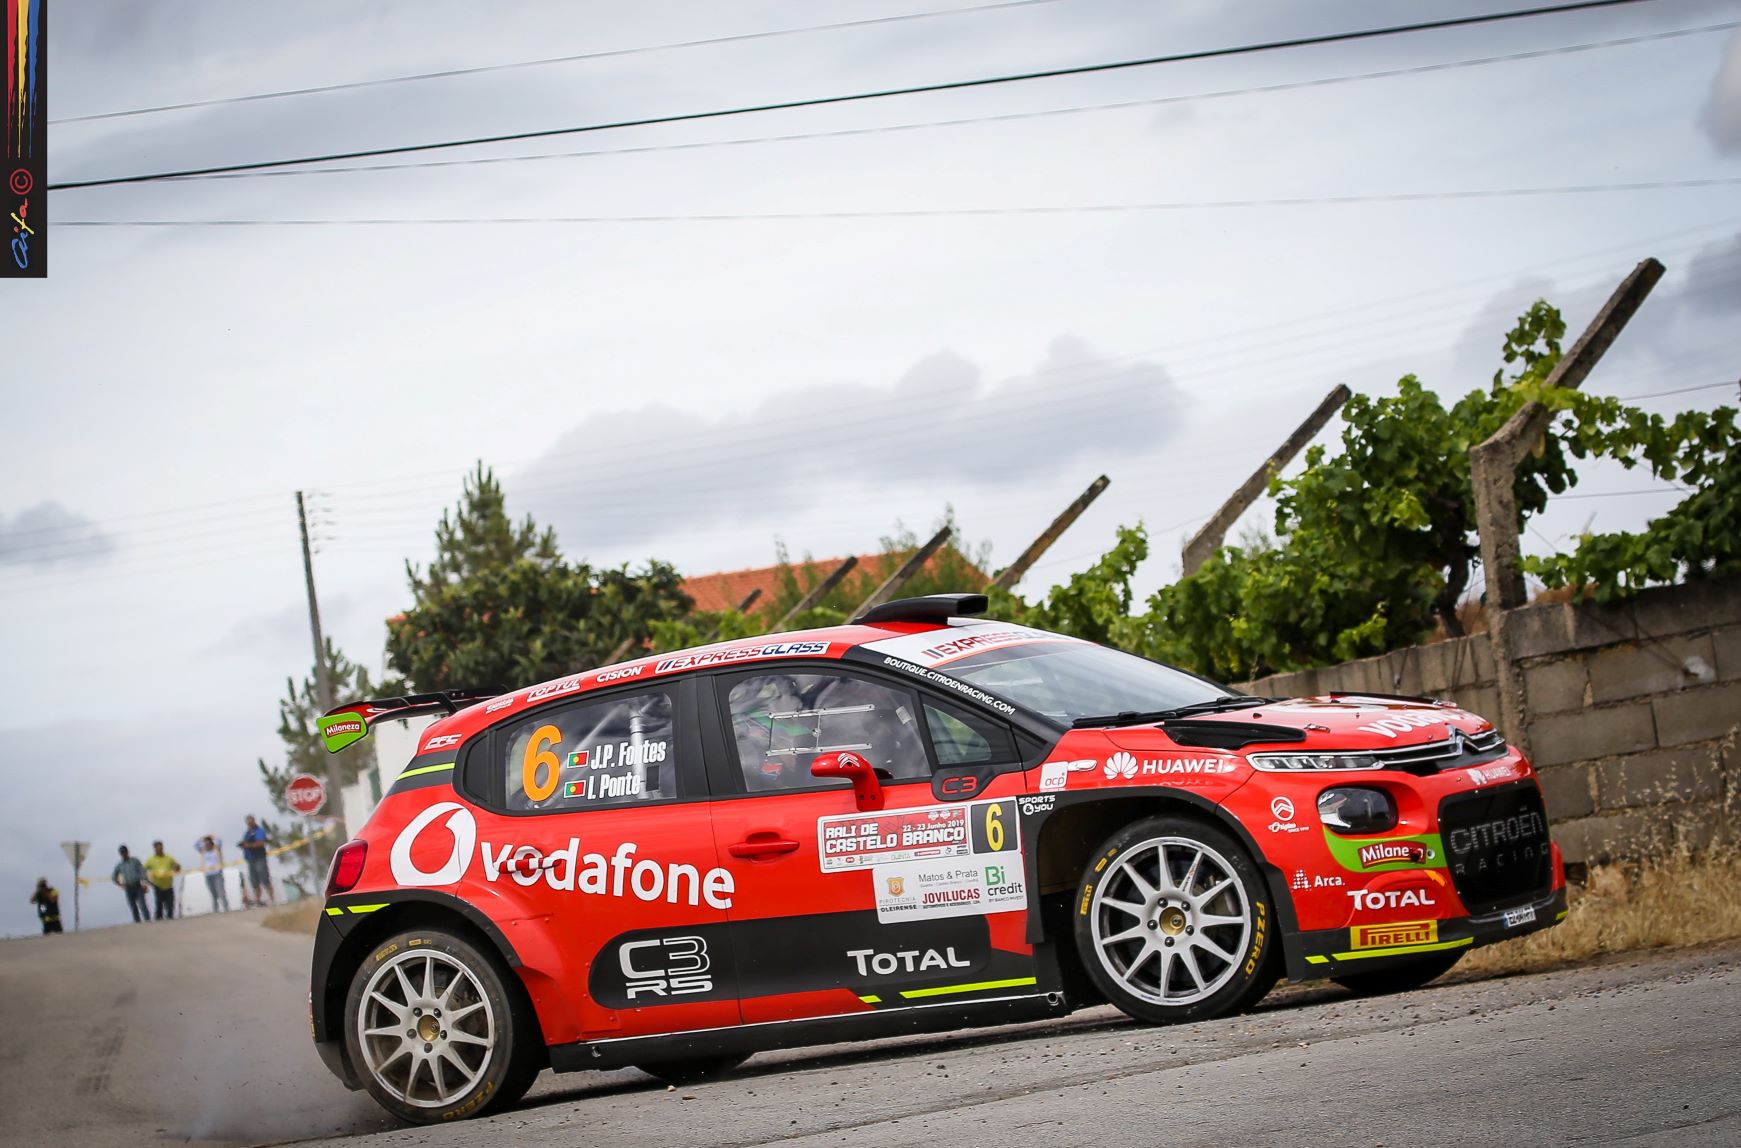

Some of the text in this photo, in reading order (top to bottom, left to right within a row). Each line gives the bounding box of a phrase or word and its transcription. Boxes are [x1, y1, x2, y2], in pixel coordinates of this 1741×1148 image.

[596, 666, 643, 683] CISION
[527, 679, 582, 699] TOPTUL
[884, 656, 1016, 716] BOUTIQUE.CITROENRACING.COM
[326, 723, 360, 735] Milaneza
[523, 724, 562, 802] 6
[591, 740, 667, 770] J.P. Fontes
[1142, 758, 1225, 775] HUAWEI
[599, 771, 641, 797] Ponte
[942, 776, 977, 794] C3
[1044, 776, 1065, 787] acp
[1018, 794, 1056, 805] SPORTS
[1034, 803, 1054, 813] YOU
[825, 822, 879, 840] RALI DE
[903, 824, 912, 832] 22
[917, 822, 926, 830] 23
[948, 818, 965, 828] 2019
[986, 803, 1005, 852] 6
[825, 825, 965, 854] CASTELO BRANCO
[480, 837, 736, 910] vodafone
[918, 873, 945, 883] Matos
[955, 869, 979, 880] Prata
[985, 866, 1006, 886] Bi
[922, 888, 981, 904] JOVILUCAS
[987, 882, 1023, 896] credit
[880, 904, 918, 913] OLEIRENSE
[1347, 889, 1435, 911] TOTAL
[1360, 923, 1431, 946] PIRELLI
[619, 935, 711, 980] C3
[846, 946, 970, 976] TOTAL
[625, 974, 713, 999] RS
